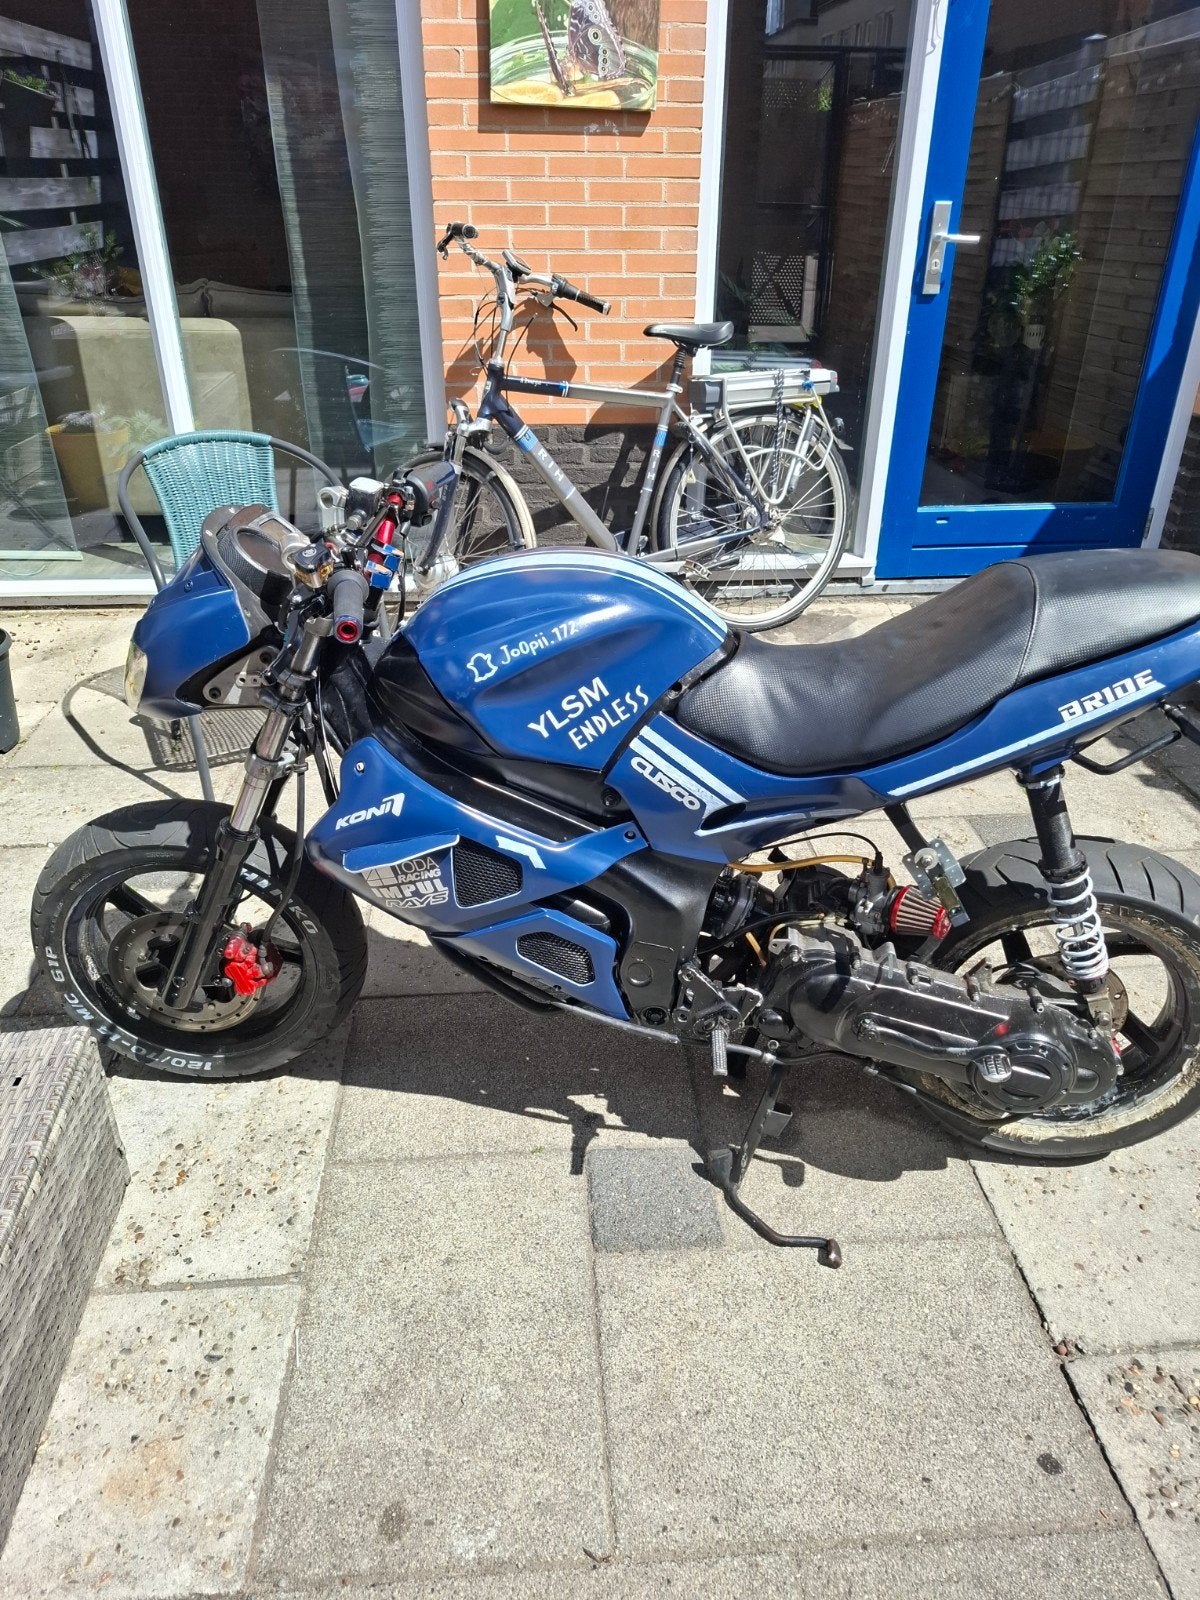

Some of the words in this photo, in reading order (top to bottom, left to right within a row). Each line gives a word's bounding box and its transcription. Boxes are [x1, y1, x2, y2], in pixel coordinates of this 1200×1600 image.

[647, 449, 660, 481] RIH
[527, 676, 610, 739] YLSM
[1058, 669, 1157, 722] BRIDE
[568, 684, 649, 750] ENDLESS
[630, 756, 701, 810] CUSCO
[335, 800, 392, 830] KONI
[371, 879, 448, 899] IMPUL
[397, 868, 442, 883] RACING
[386, 891, 448, 908] RAYS
[64, 993, 94, 1022] M/C
